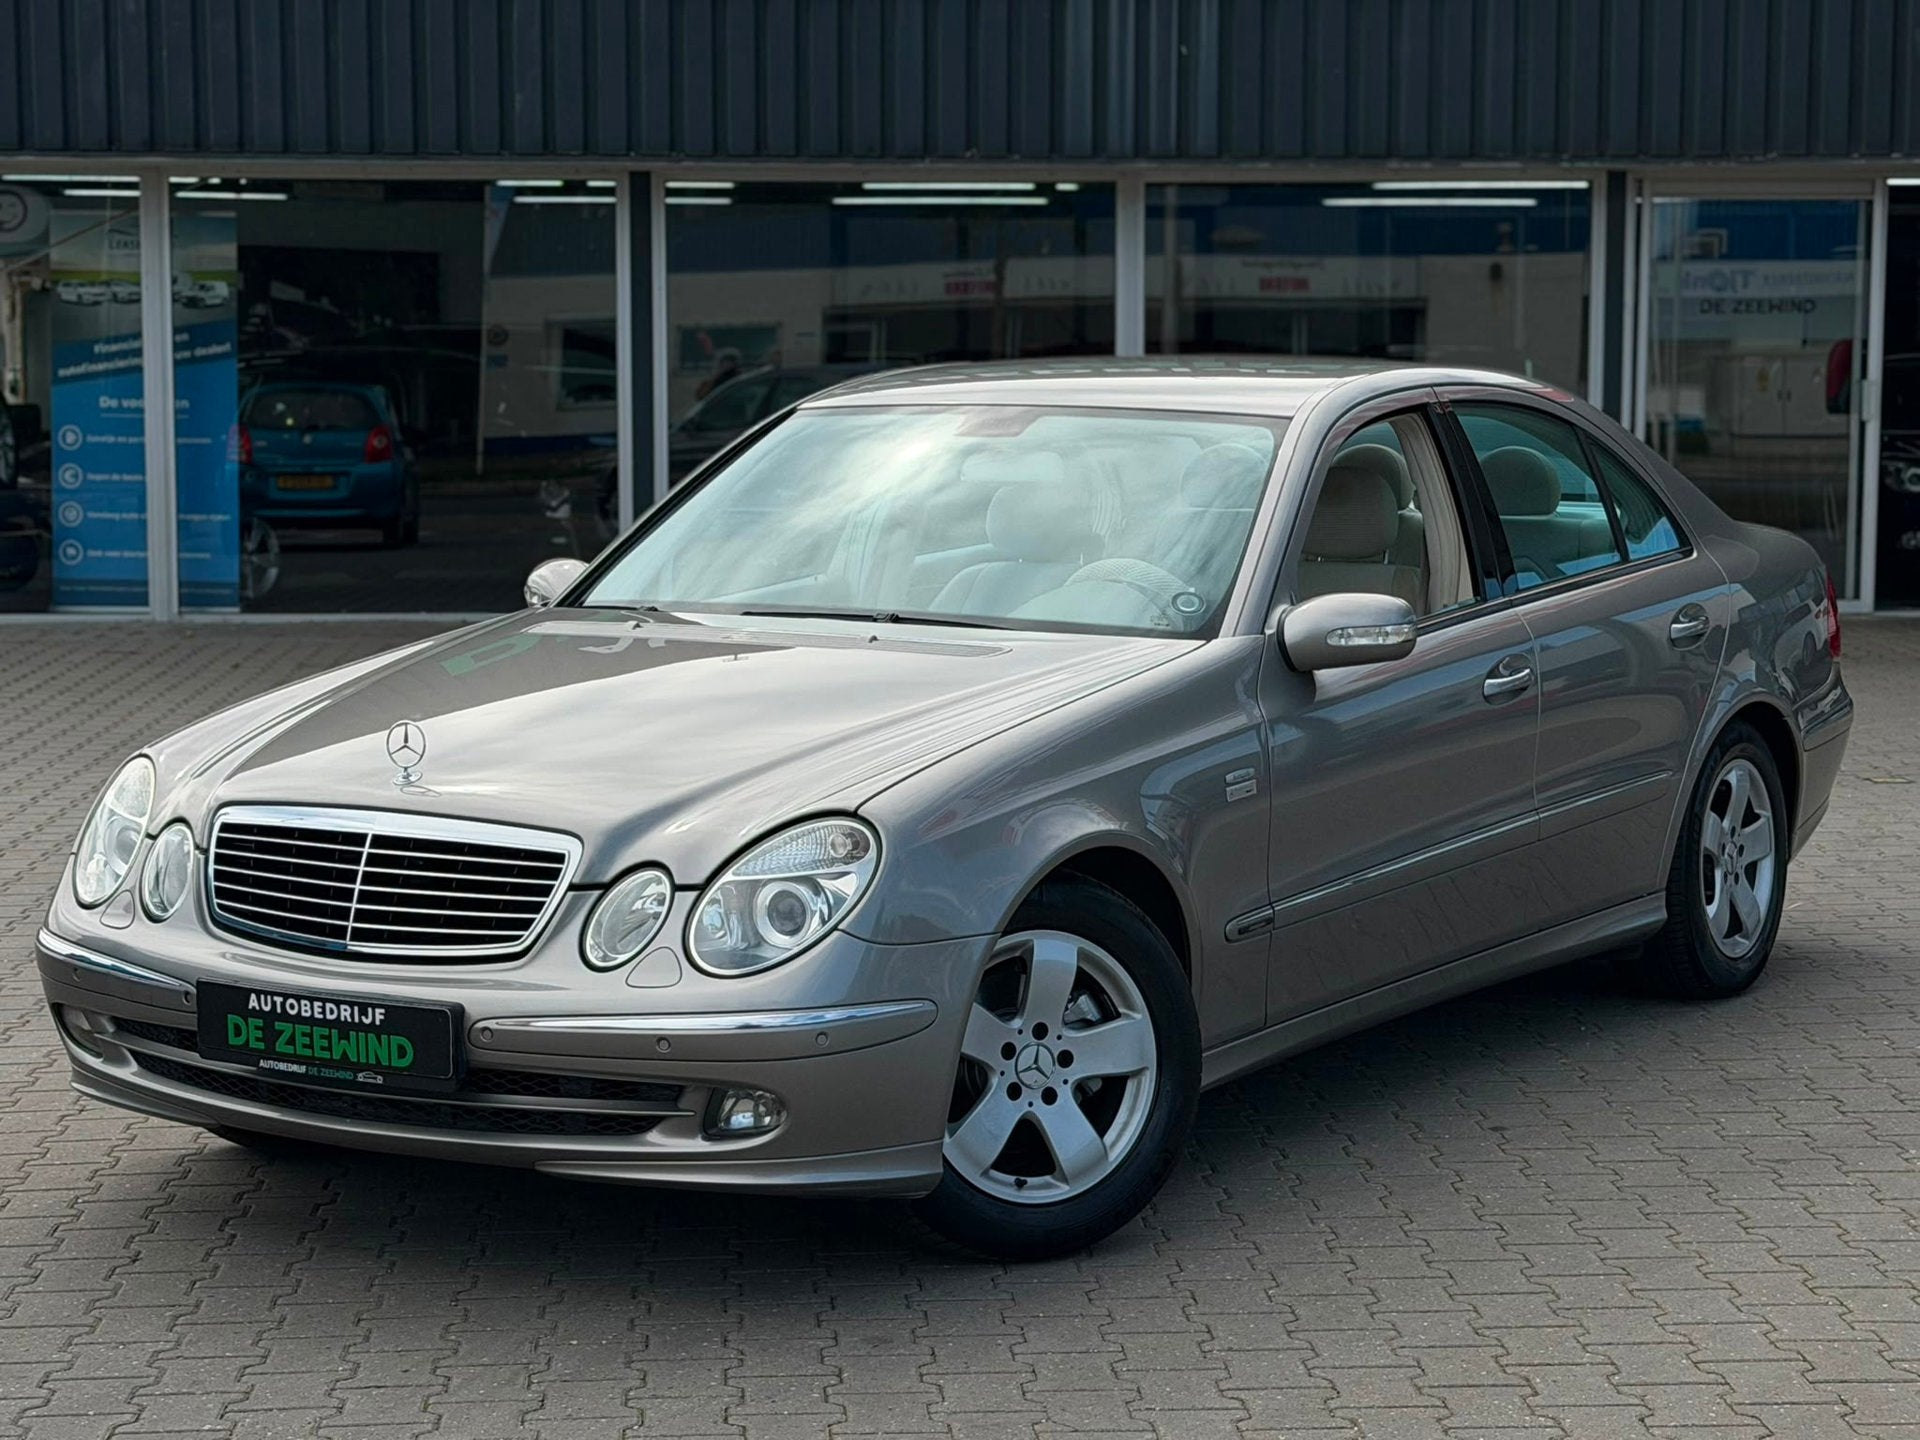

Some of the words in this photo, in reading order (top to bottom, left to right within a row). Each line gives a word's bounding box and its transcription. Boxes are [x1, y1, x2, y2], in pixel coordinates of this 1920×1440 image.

[1699, 298, 1725, 314] DE
[248, 992, 386, 1026] AUTOBEDRIJF
[227, 1013, 266, 1050] DE
[274, 1020, 415, 1068] ZEEWIND
[258, 1058, 307, 1075] AUTOBEDRIJF
[307, 1066, 319, 1077] DE
